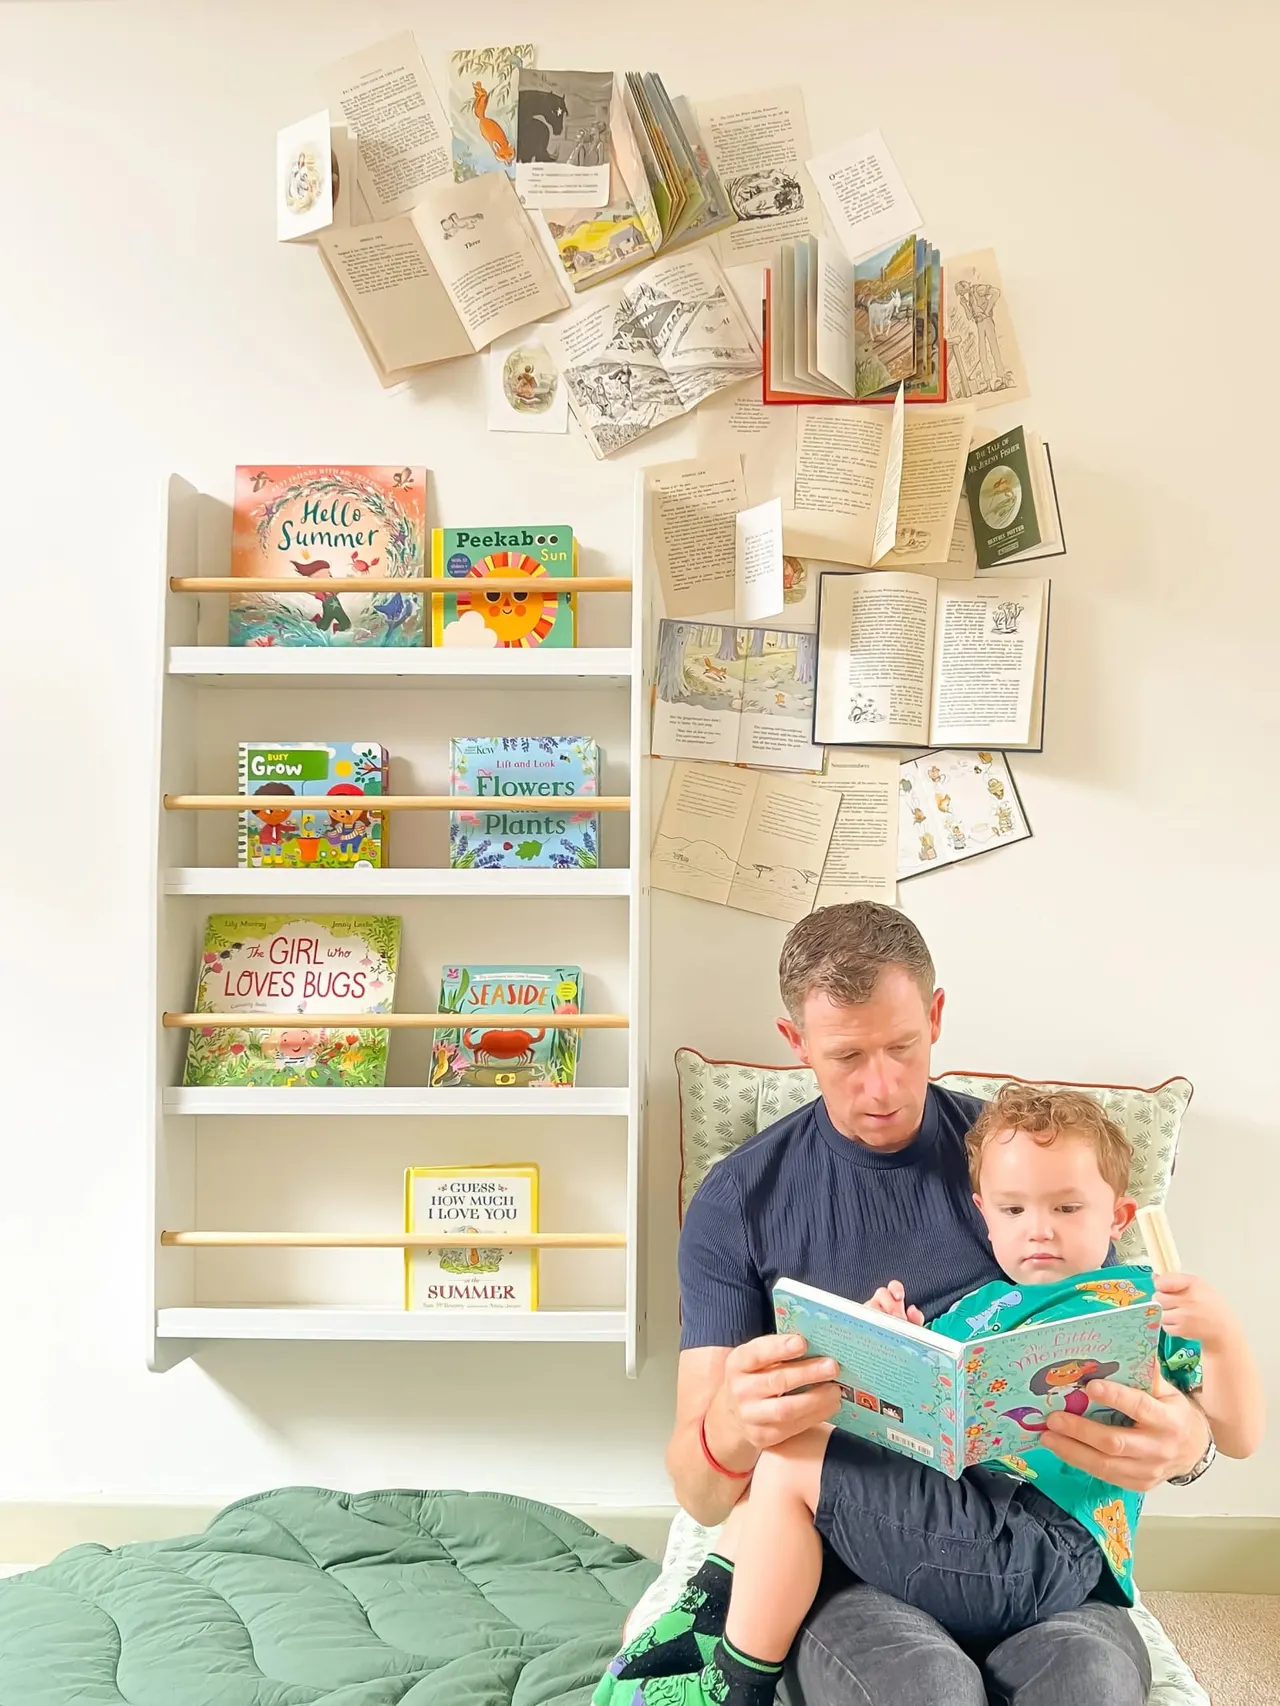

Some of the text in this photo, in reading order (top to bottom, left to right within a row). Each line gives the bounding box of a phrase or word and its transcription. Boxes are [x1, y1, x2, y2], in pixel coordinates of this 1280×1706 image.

[300, 499, 362, 527] Hello
[278, 520, 379, 551] Summer
[456, 531, 559, 548] Peekaboo
[540, 549, 567, 562] Sun
[251, 756, 303, 776] Grow
[267, 753, 289, 761] BUSY
[496, 760, 556, 769] Lift and Look
[476, 775, 575, 797] Flowers
[484, 814, 566, 835] Plants
[331, 920, 351, 930] Jenny
[246, 944, 265, 958] The
[269, 936, 325, 965] GIRL
[224, 970, 367, 998] LOVES BUGS
[467, 983, 550, 1006] SEASIDE
[450, 1182, 496, 1193] GUESS
[431, 1195, 514, 1206] HOW MUCH
[428, 1208, 517, 1220] I LOVE YOU
[427, 1285, 516, 1299] SUMMER
[1054, 1327, 1101, 1347] Little
[1008, 1338, 1114, 1371] Mermaid
